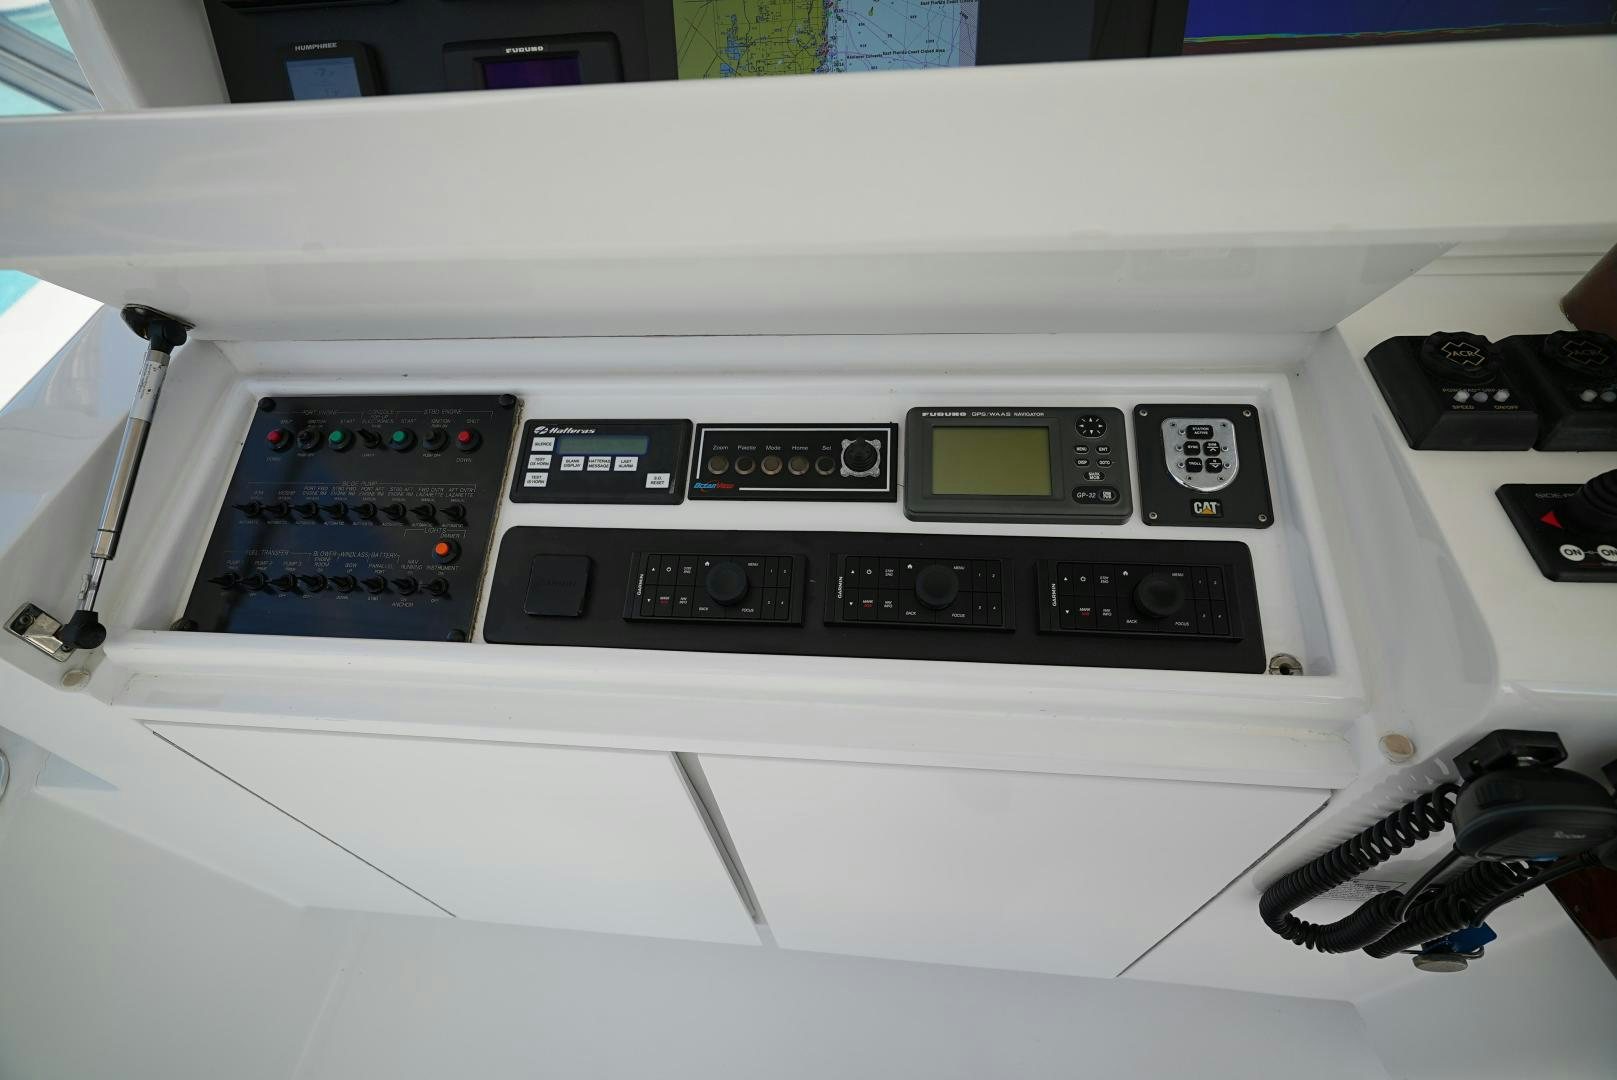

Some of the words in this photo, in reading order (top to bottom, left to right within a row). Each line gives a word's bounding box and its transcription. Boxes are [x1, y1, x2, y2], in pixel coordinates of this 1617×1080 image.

[294, 42, 338, 51] HUMPHREE
[505, 45, 544, 54] FURUNO
[549, 426, 596, 435] Hatteras
[1076, 491, 1097, 499] GP-32
[1193, 501, 1218, 515] CAT
[1564, 548, 1582, 556] ON
[636, 573, 644, 596] GARMIN
